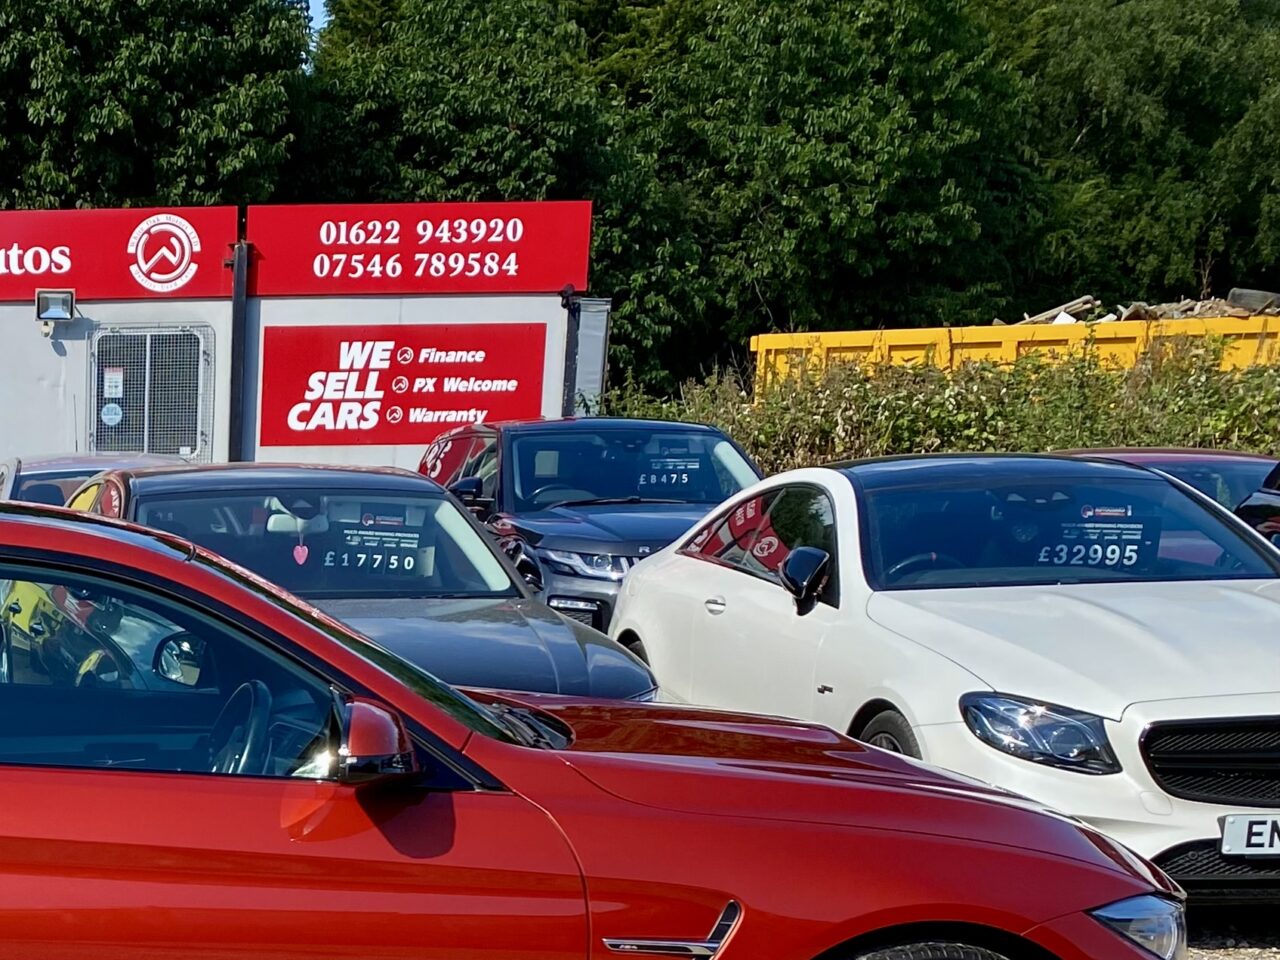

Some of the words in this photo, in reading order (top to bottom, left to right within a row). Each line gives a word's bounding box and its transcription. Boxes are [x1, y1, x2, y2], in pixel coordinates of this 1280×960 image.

[319, 219, 401, 245] 01622
[415, 218, 524, 245] 943920
[312, 252, 403, 278] 07546
[413, 251, 520, 277] 789584
[338, 341, 396, 370] WE
[417, 348, 486, 364] Finance
[304, 370, 385, 401] SELL
[412, 377, 438, 393] PX
[442, 376, 519, 392] Welcome
[287, 401, 382, 431] CARS
[407, 407, 489, 425] Warranty
[1038, 543, 1139, 566] £32995
